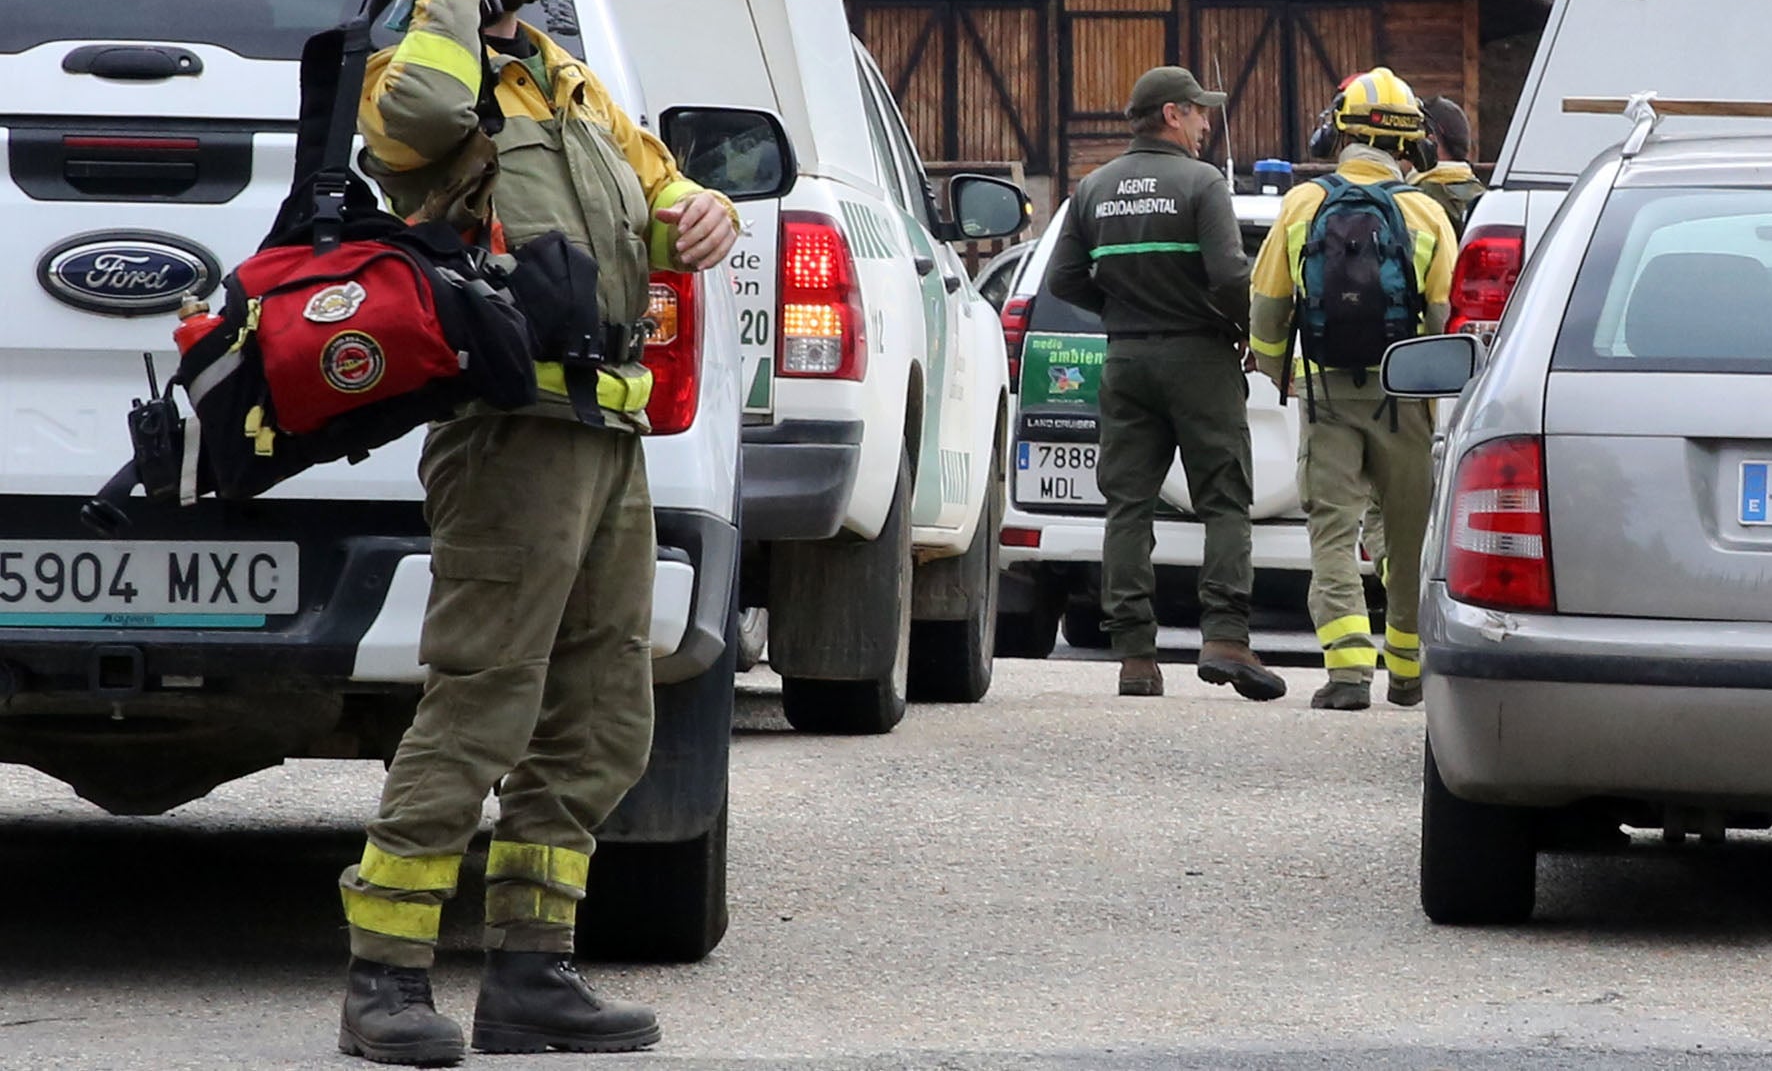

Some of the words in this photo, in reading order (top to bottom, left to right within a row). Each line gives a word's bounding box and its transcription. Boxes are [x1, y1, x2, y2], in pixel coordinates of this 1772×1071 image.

[1117, 177, 1158, 195] AGENTE
[730, 250, 761, 271] de
[86, 253, 170, 289] Ford
[1032, 339, 1063, 350] medio
[1049, 348, 1106, 365] ambien
[1027, 418, 1053, 428] LAND
[1055, 419, 1096, 429] CRUISER
[1038, 446, 1096, 469] 7888
[1040, 477, 1083, 499] MDL
[1748, 498, 1761, 513] E
[0, 551, 138, 603] 5904
[168, 552, 278, 604] MXC
